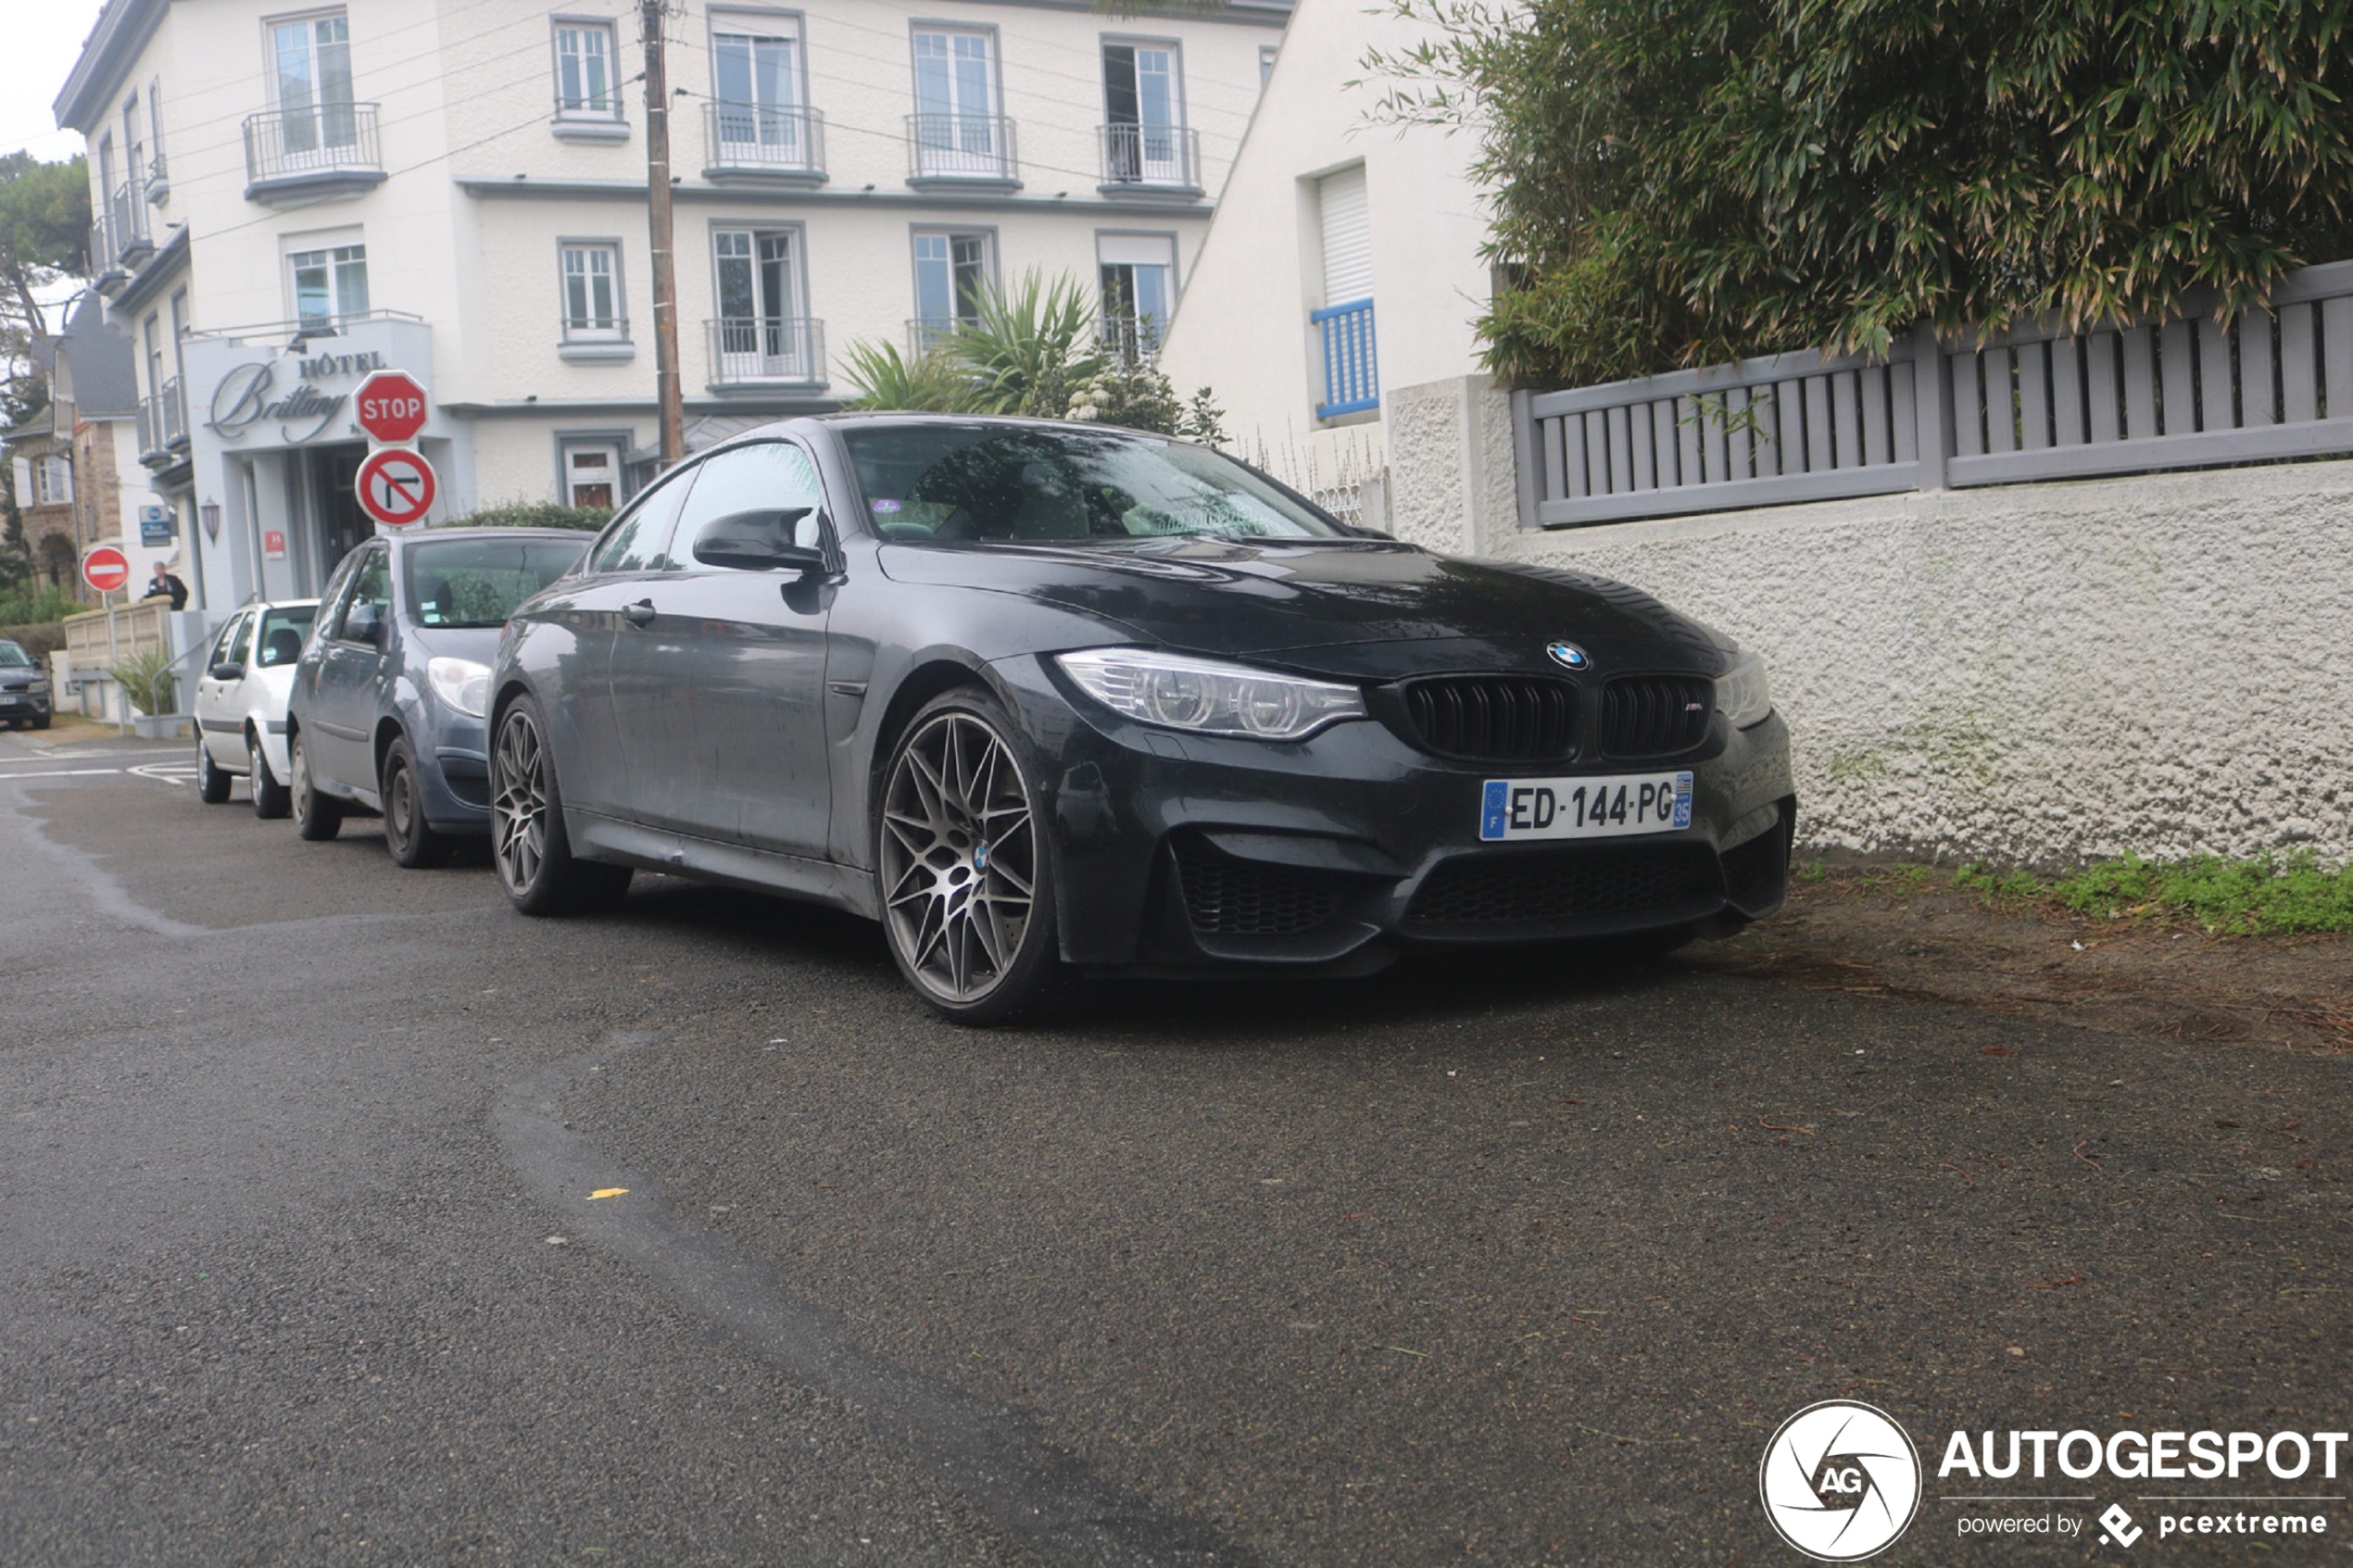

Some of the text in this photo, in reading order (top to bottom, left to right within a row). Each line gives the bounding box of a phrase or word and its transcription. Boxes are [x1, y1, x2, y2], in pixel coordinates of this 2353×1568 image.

[363, 397, 422, 420] STOP
[1510, 782, 1673, 829] ED-144-PG
[1675, 802, 1689, 822] 35
[1490, 816, 1498, 829] F
